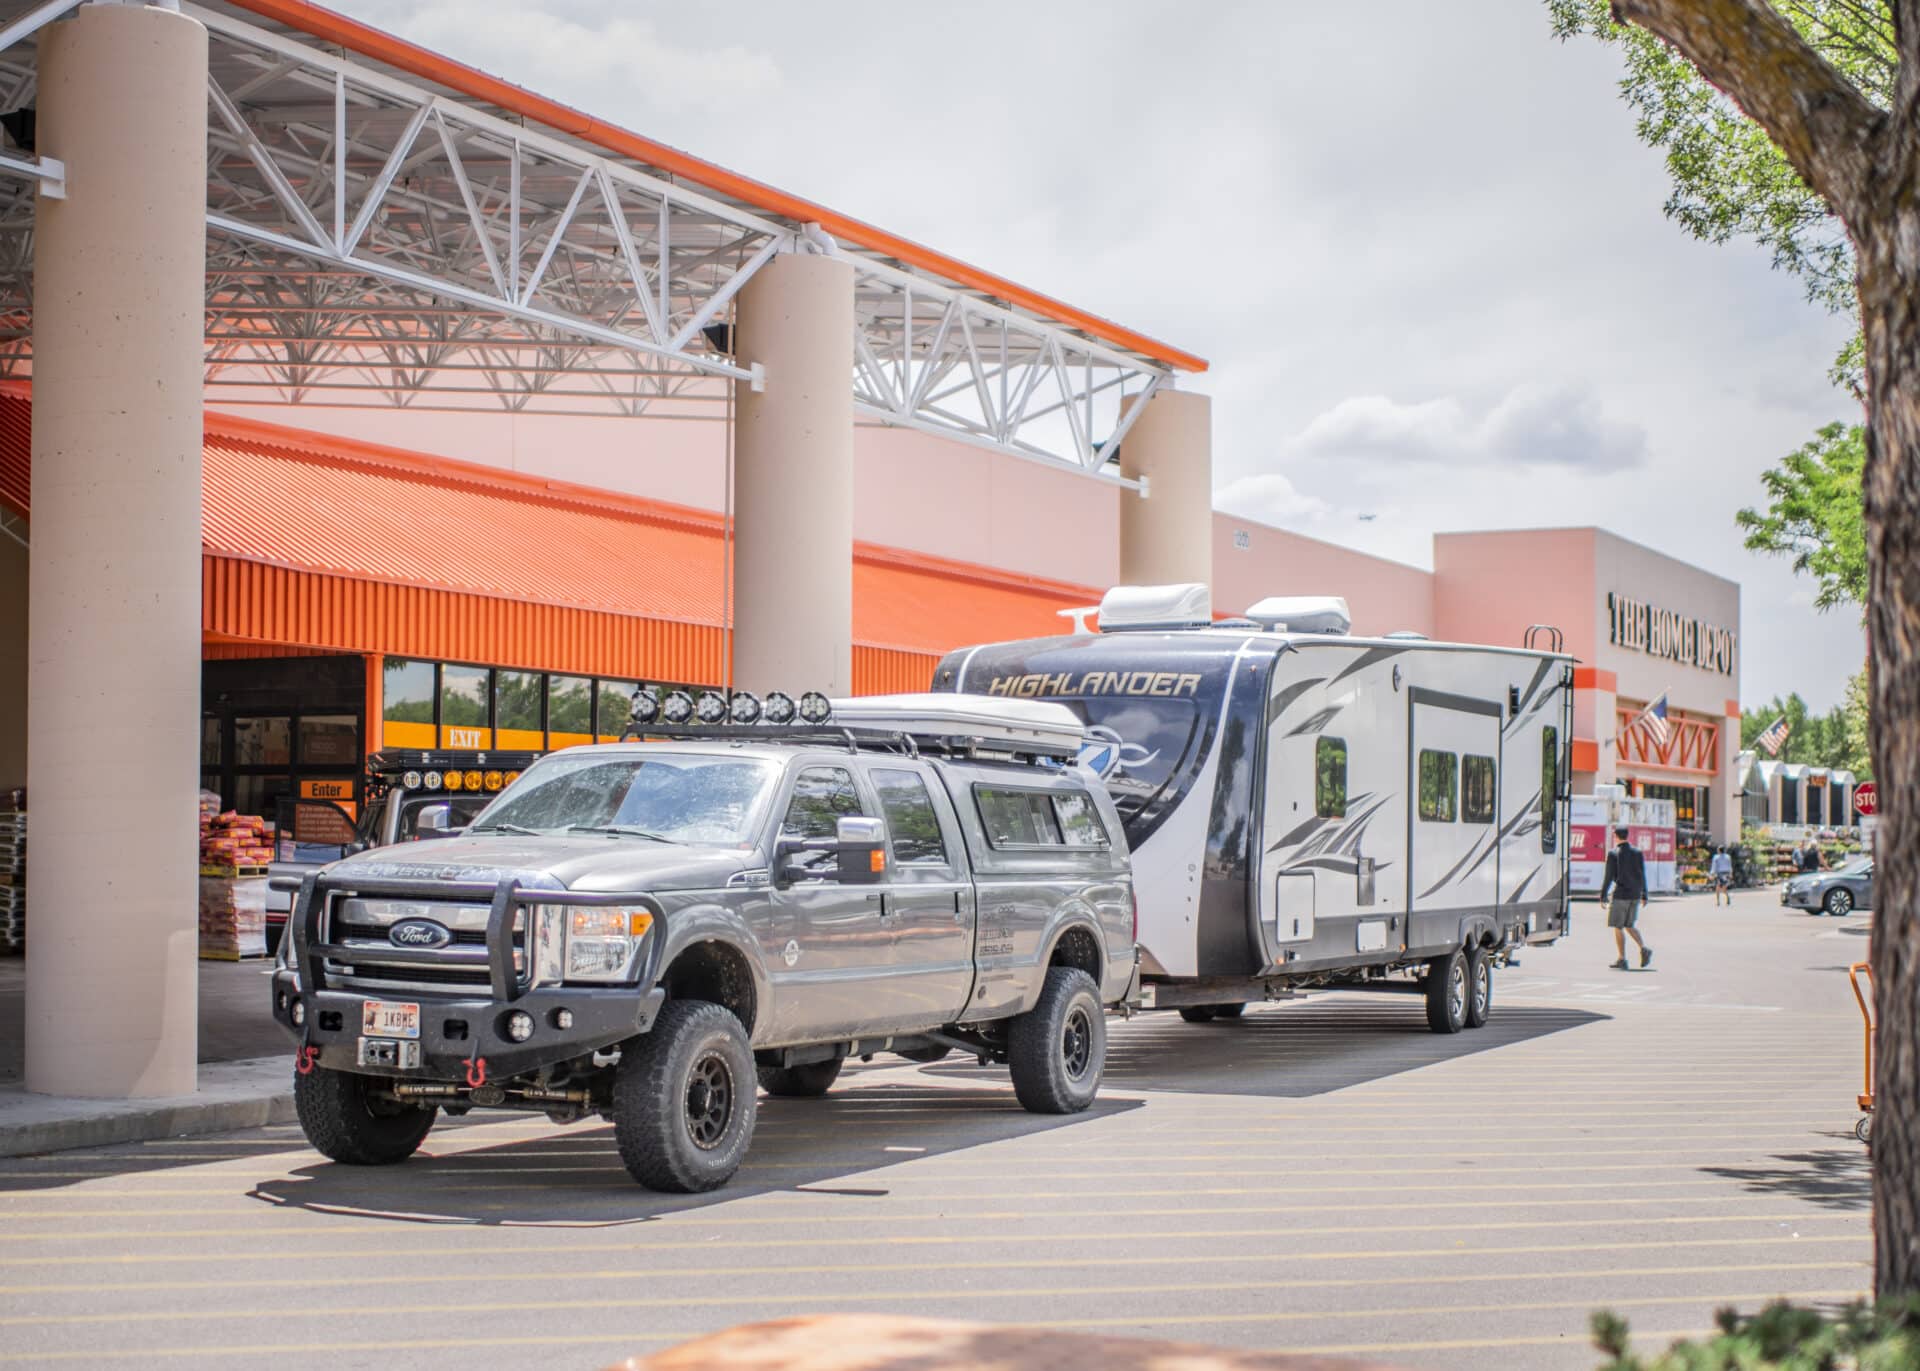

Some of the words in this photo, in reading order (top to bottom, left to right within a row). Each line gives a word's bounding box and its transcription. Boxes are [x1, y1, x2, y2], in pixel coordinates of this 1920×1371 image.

[1607, 591, 1645, 651] THE
[1646, 604, 1693, 664] HOME
[1692, 620, 1736, 676] DEPOT
[987, 671, 1202, 697] HIGHLANDER
[449, 729, 481, 748] EXIT
[311, 783, 342, 797] Enter
[1855, 791, 1878, 806] STO
[400, 925, 433, 943] Ford
